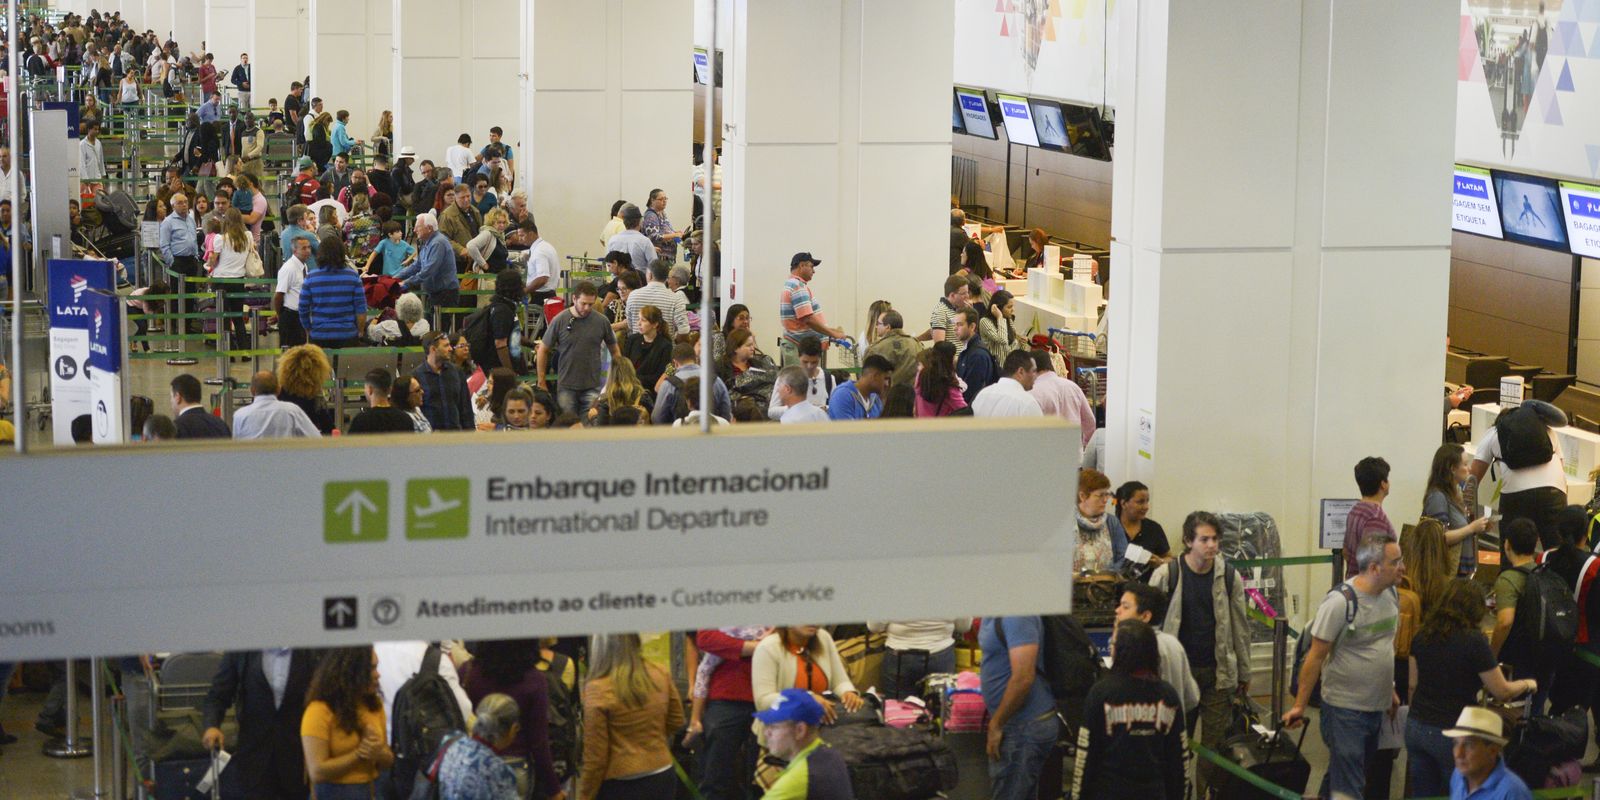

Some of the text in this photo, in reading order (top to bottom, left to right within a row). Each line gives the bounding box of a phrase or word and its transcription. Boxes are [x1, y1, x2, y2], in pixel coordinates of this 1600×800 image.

[1461, 182, 1485, 193] LATAM
[1478, 203, 1492, 213] SEM
[1456, 213, 1486, 225] ETIQUETA
[487, 466, 829, 503] Embarque Internacional
[486, 507, 769, 536] International Departure
[416, 584, 835, 618] Atendimento ao cliente Customer Service
